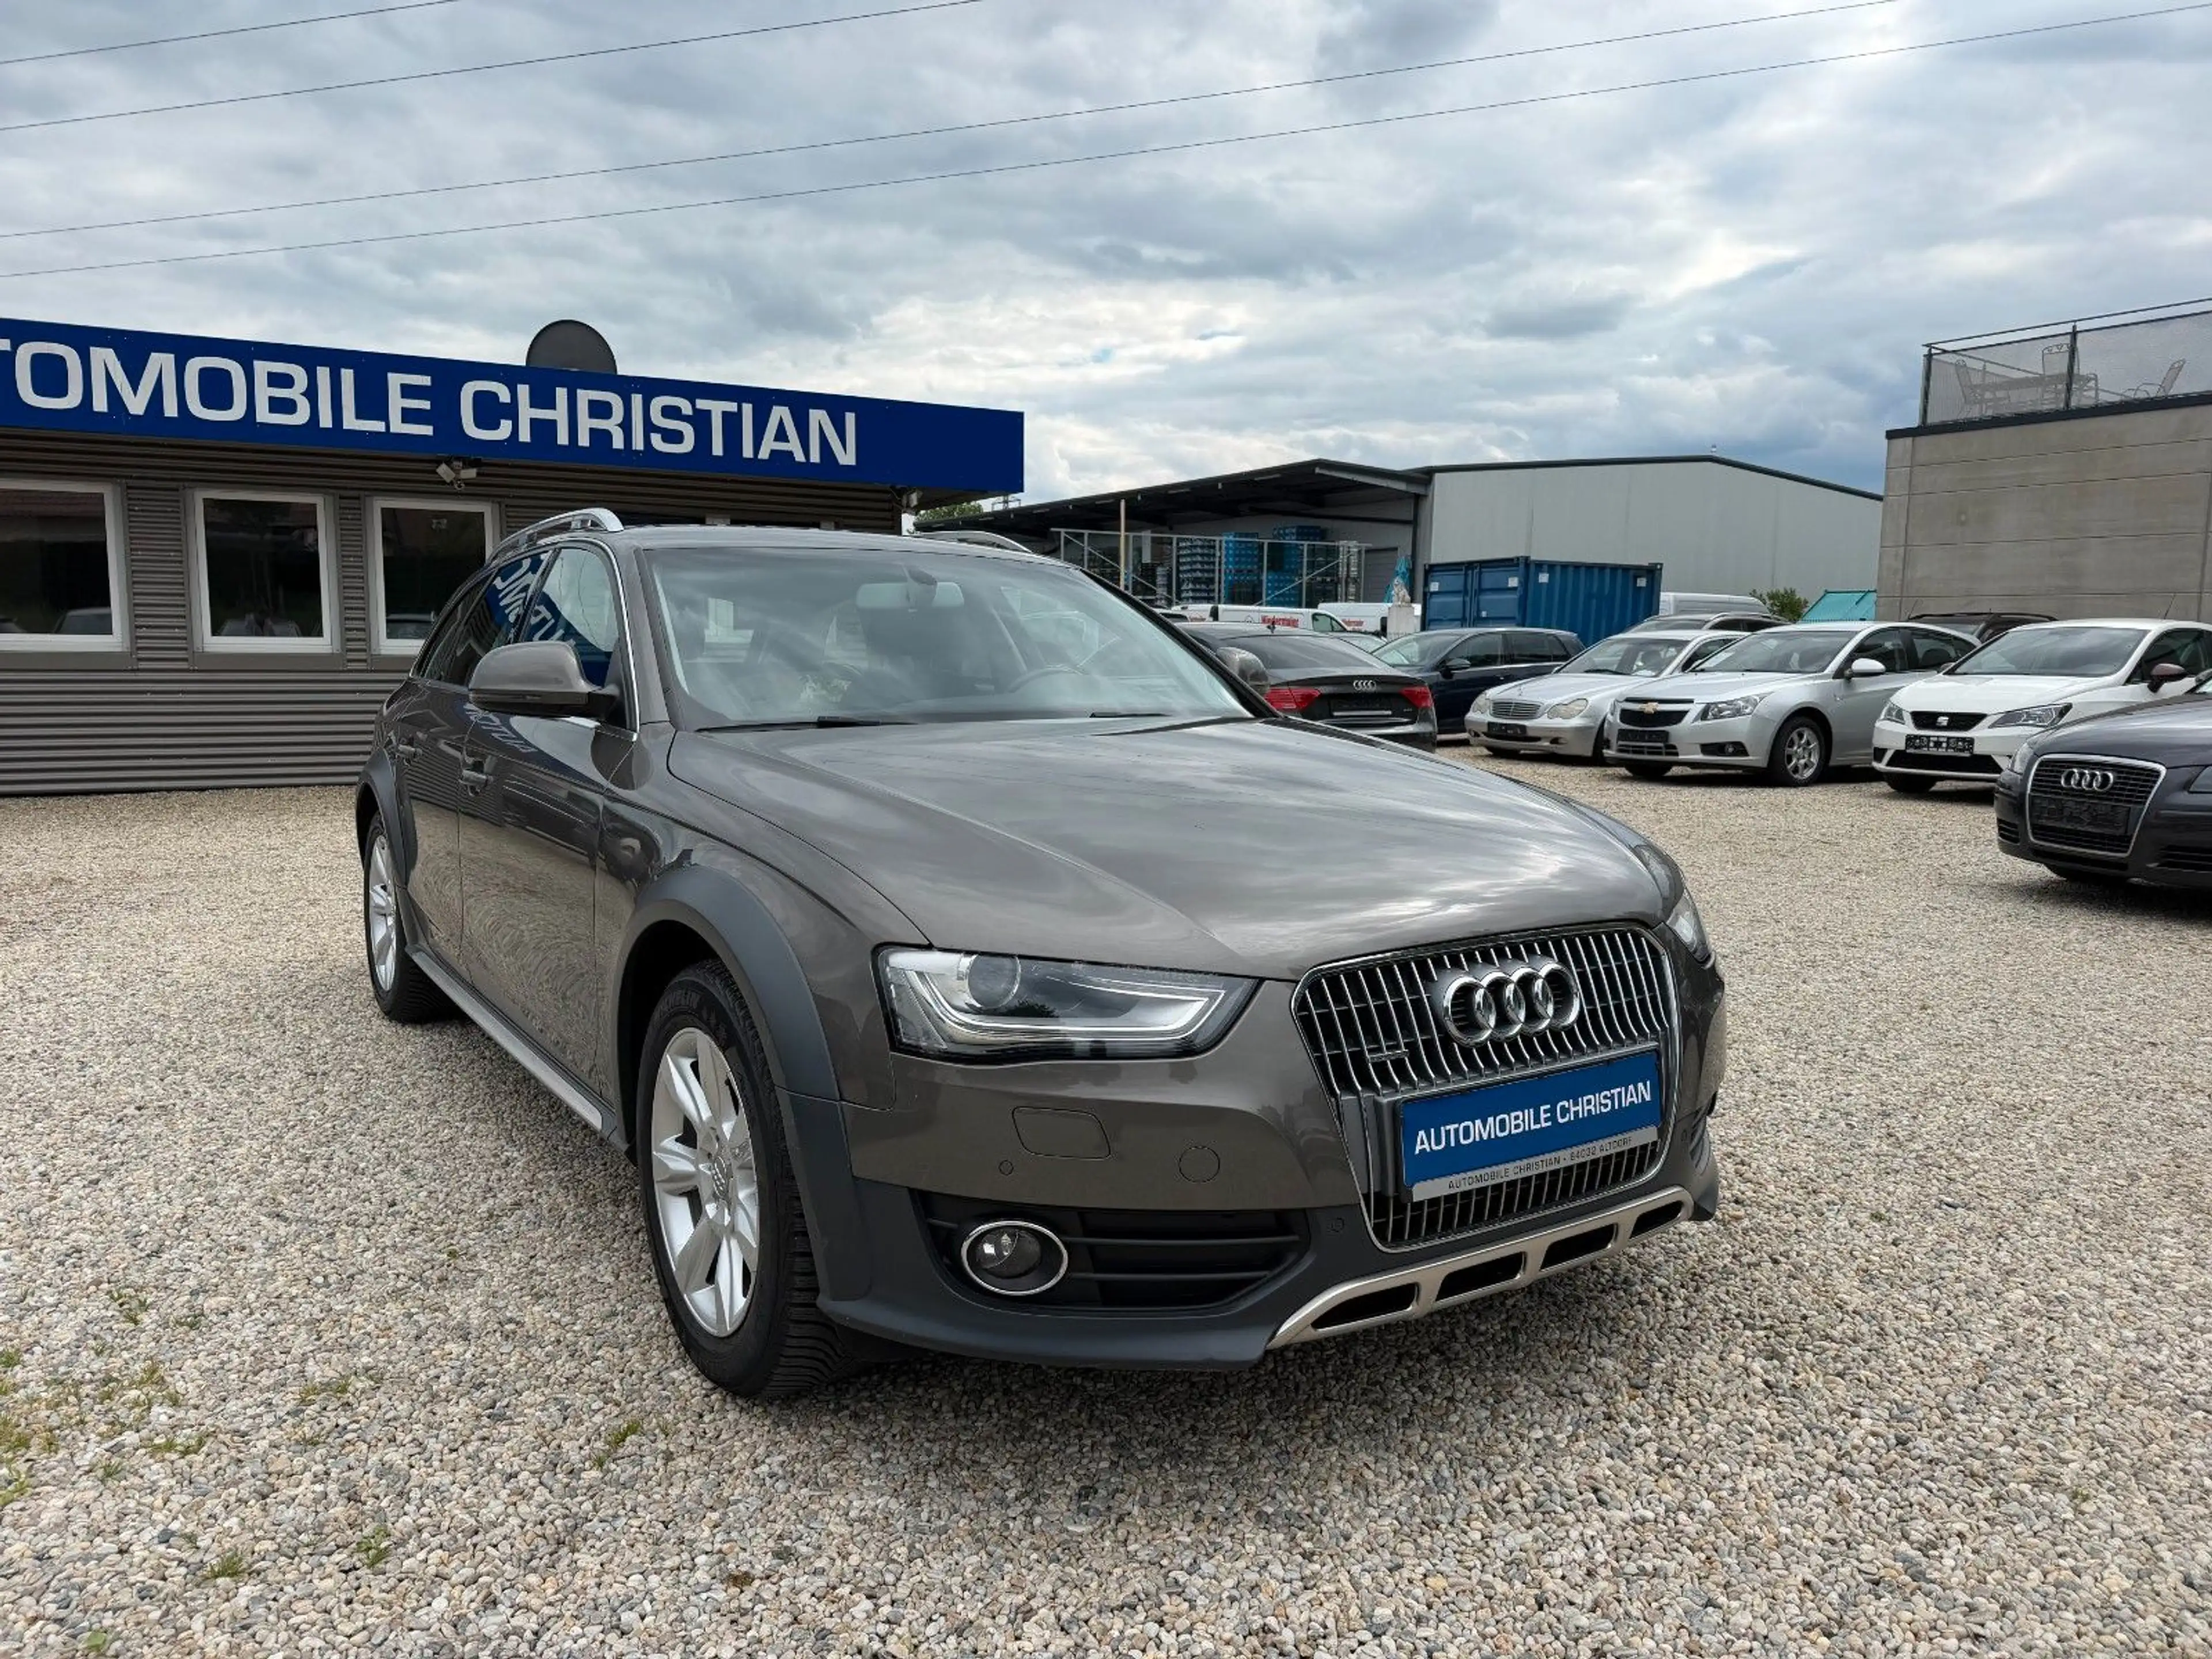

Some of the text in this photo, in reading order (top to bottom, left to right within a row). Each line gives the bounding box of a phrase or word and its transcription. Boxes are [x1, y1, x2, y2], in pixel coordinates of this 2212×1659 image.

[0, 339, 857, 466] OMOBILE CHRISTIAN
[1415, 1081, 1652, 1154] AUTOMOBILE CHRISTIAN
[1448, 1168, 1509, 1190] AUTOMOBILE
[1513, 1156, 1560, 1176] CHRISTIAN
